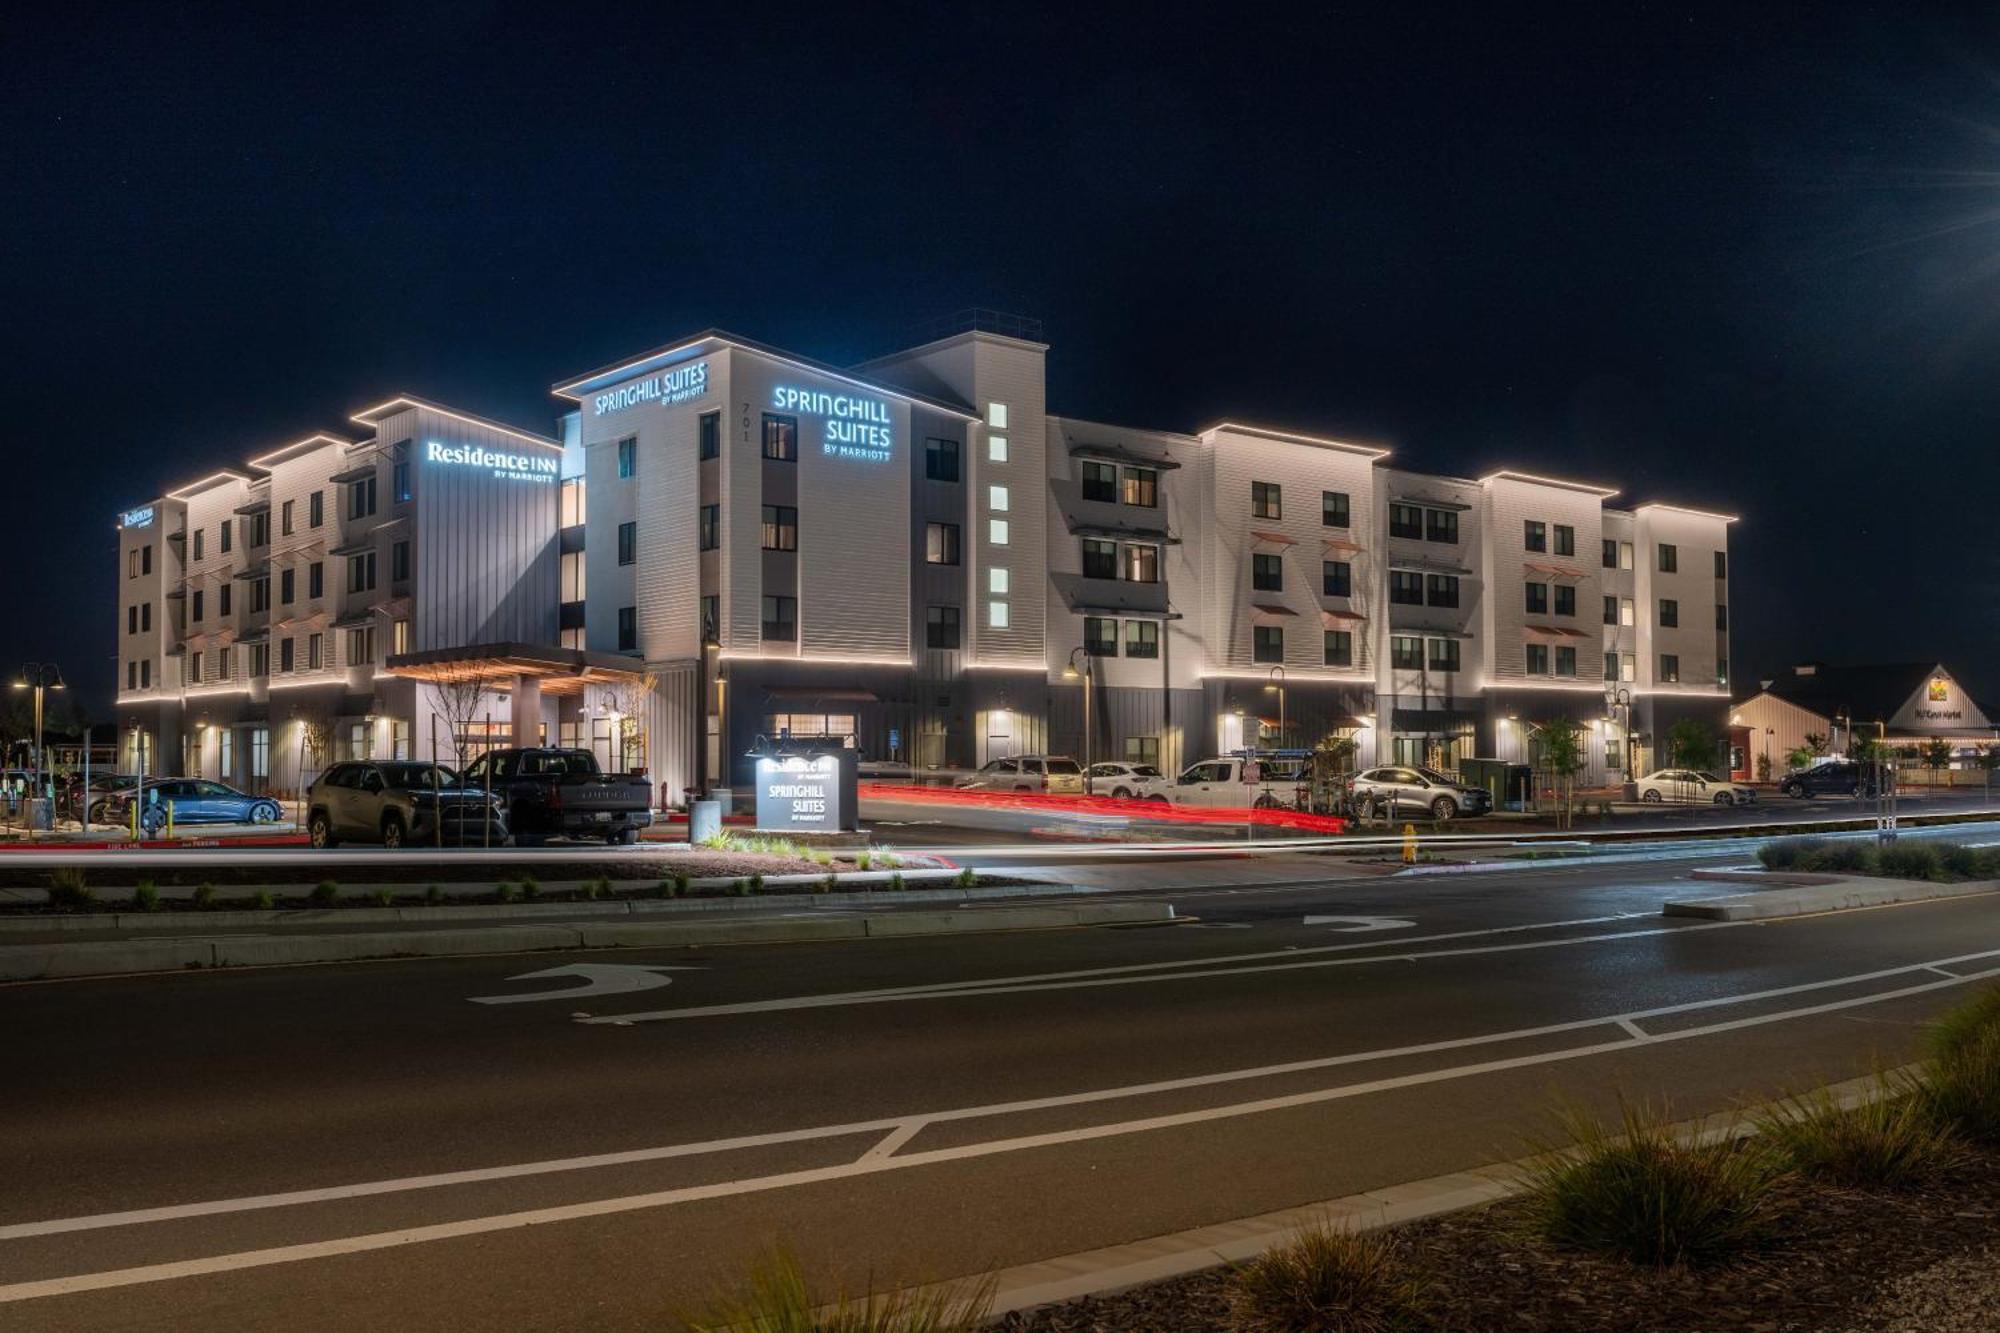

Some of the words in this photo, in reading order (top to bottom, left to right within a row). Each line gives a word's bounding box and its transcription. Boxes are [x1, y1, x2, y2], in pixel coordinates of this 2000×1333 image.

[594, 378, 661, 415] SPRINGHILL
[664, 362, 705, 394] SUITES
[774, 387, 891, 424] SPRINGHILL
[827, 420, 891, 447] SUITES
[428, 442, 529, 471] Residence
[530, 457, 557, 473] INN
[824, 443, 837, 455] BY
[840, 445, 890, 461] MARRIOTT
[494, 470, 506, 478] BY
[508, 471, 554, 483] MARRIOTT
[769, 785, 825, 798] SPRINGHILL
[792, 800, 825, 813] SUITES
